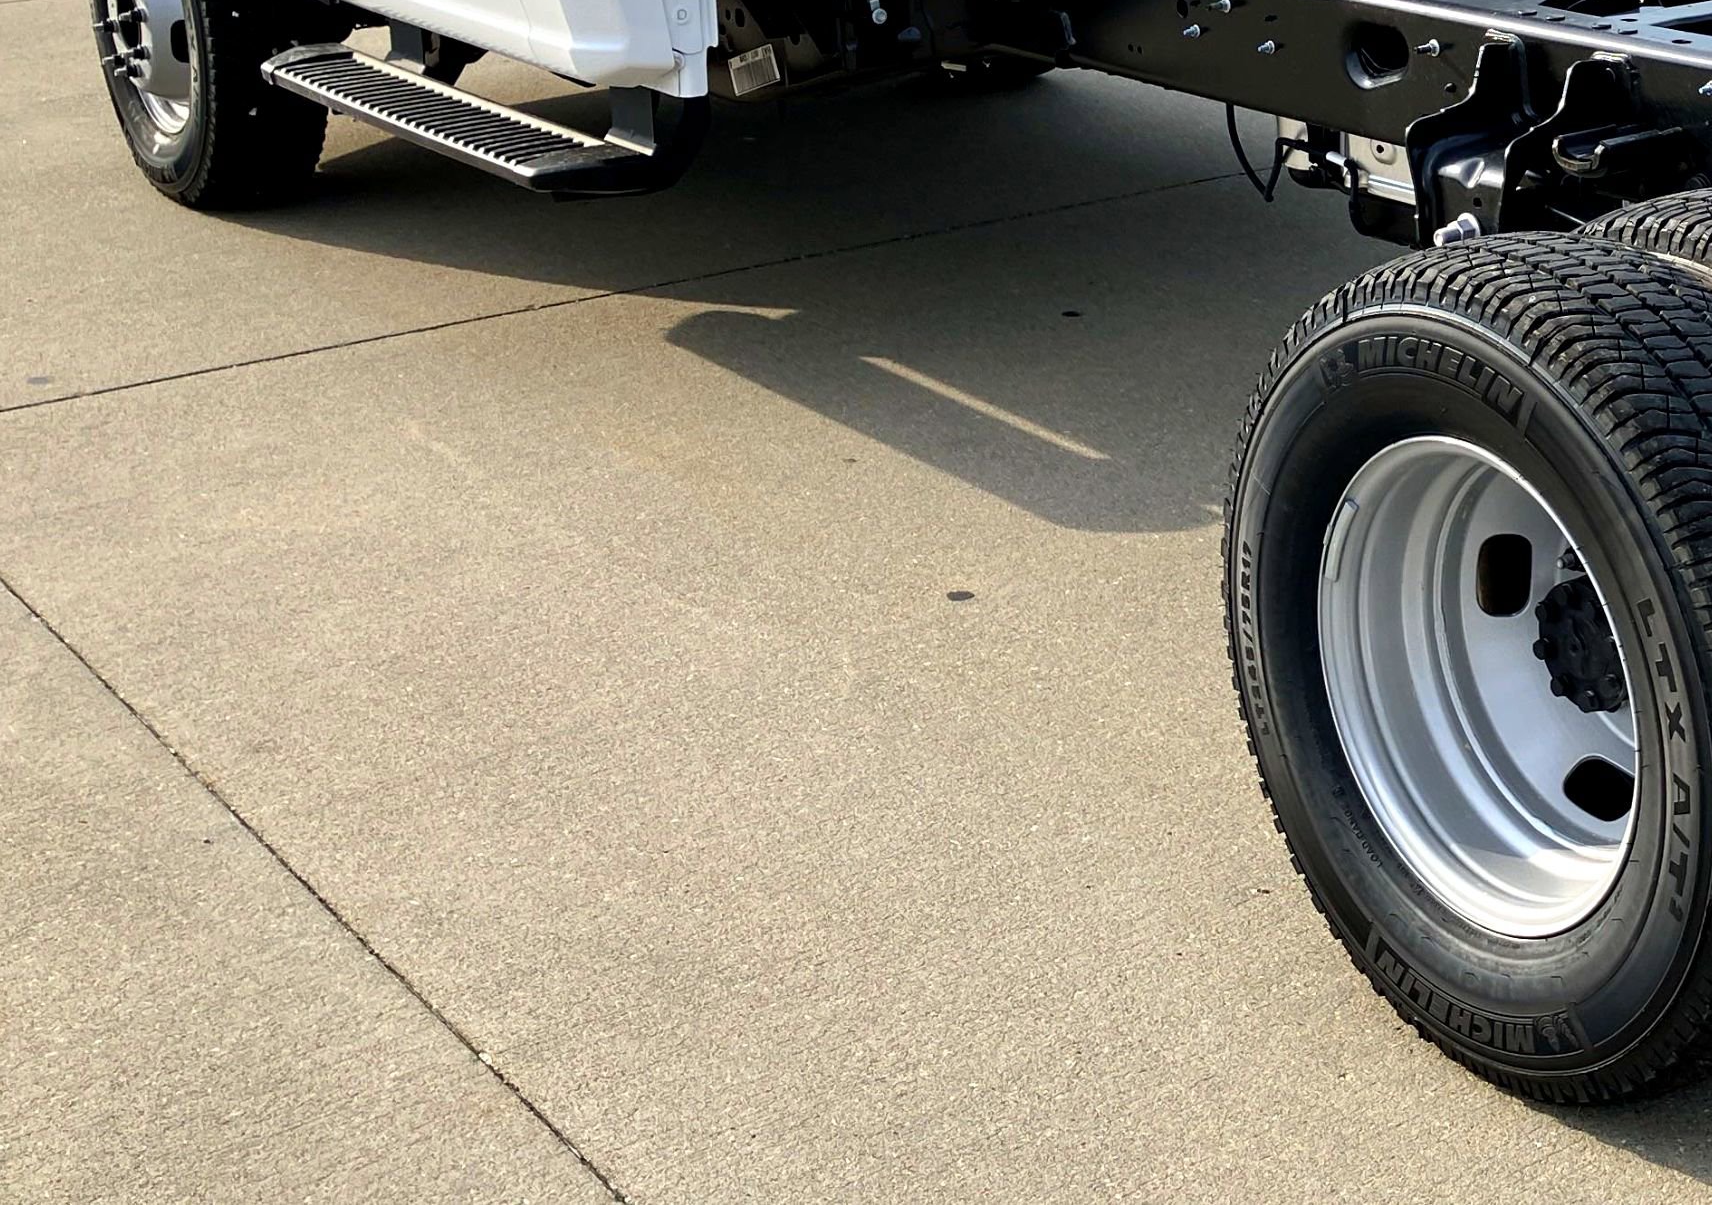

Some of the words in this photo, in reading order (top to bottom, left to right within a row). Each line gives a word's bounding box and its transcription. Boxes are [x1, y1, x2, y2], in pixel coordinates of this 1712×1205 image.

[1358, 336, 1525, 424] MICHELIN
[1637, 598, 1687, 743] LTX
[1376, 948, 1536, 1054] MICHELIN
